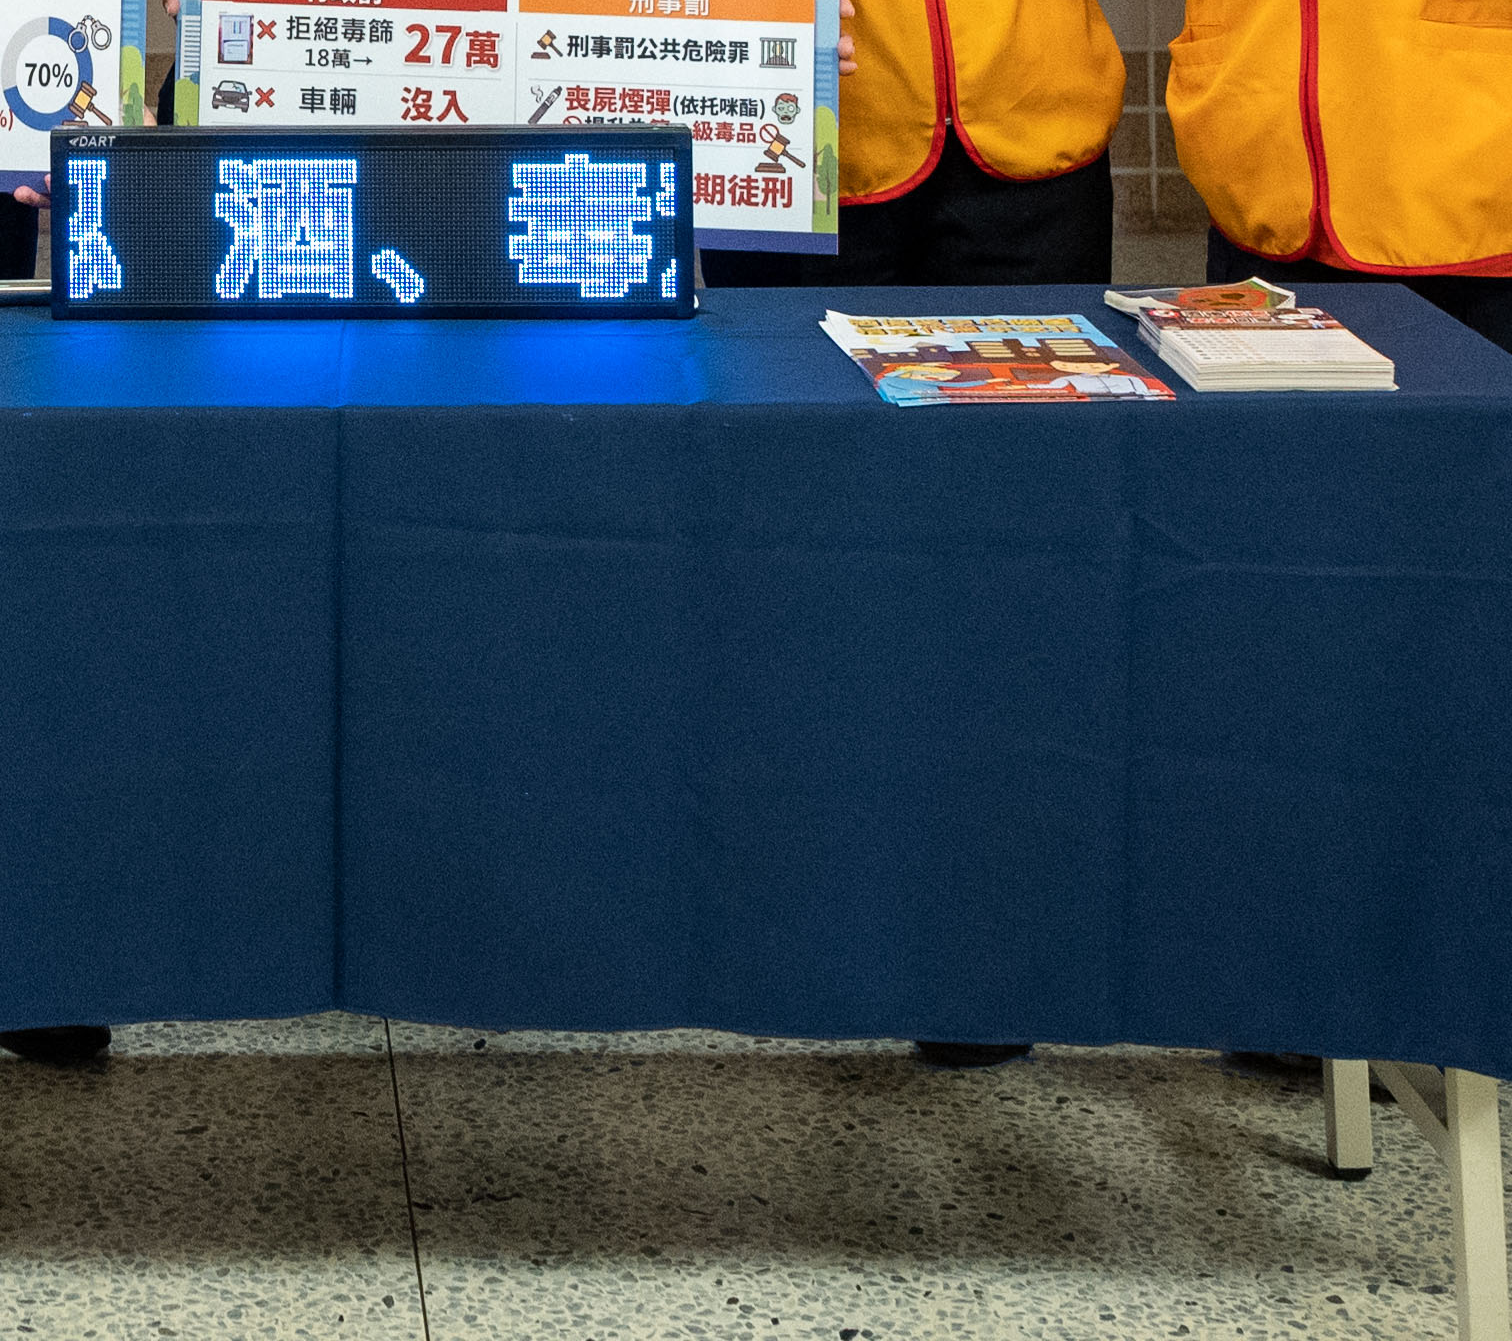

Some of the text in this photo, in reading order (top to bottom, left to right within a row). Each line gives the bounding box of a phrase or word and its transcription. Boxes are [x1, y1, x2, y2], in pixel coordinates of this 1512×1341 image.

[285, 16, 393, 45] 拒絕毒篩
[405, 22, 501, 68] 27萬
[305, 48, 349, 68] 18萬
[567, 35, 750, 64] 刑事罰公共危險罪
[25, 63, 73, 88] 70%
[300, 87, 357, 116] 車輛
[401, 89, 470, 123] 沒入
[565, 85, 766, 119] 喪屍煙彈 (依托咪酯)
[78, 136, 116, 147] DART
[694, 173, 793, 208] 期徒刑
[68, 153, 676, 303] 酒、毒
